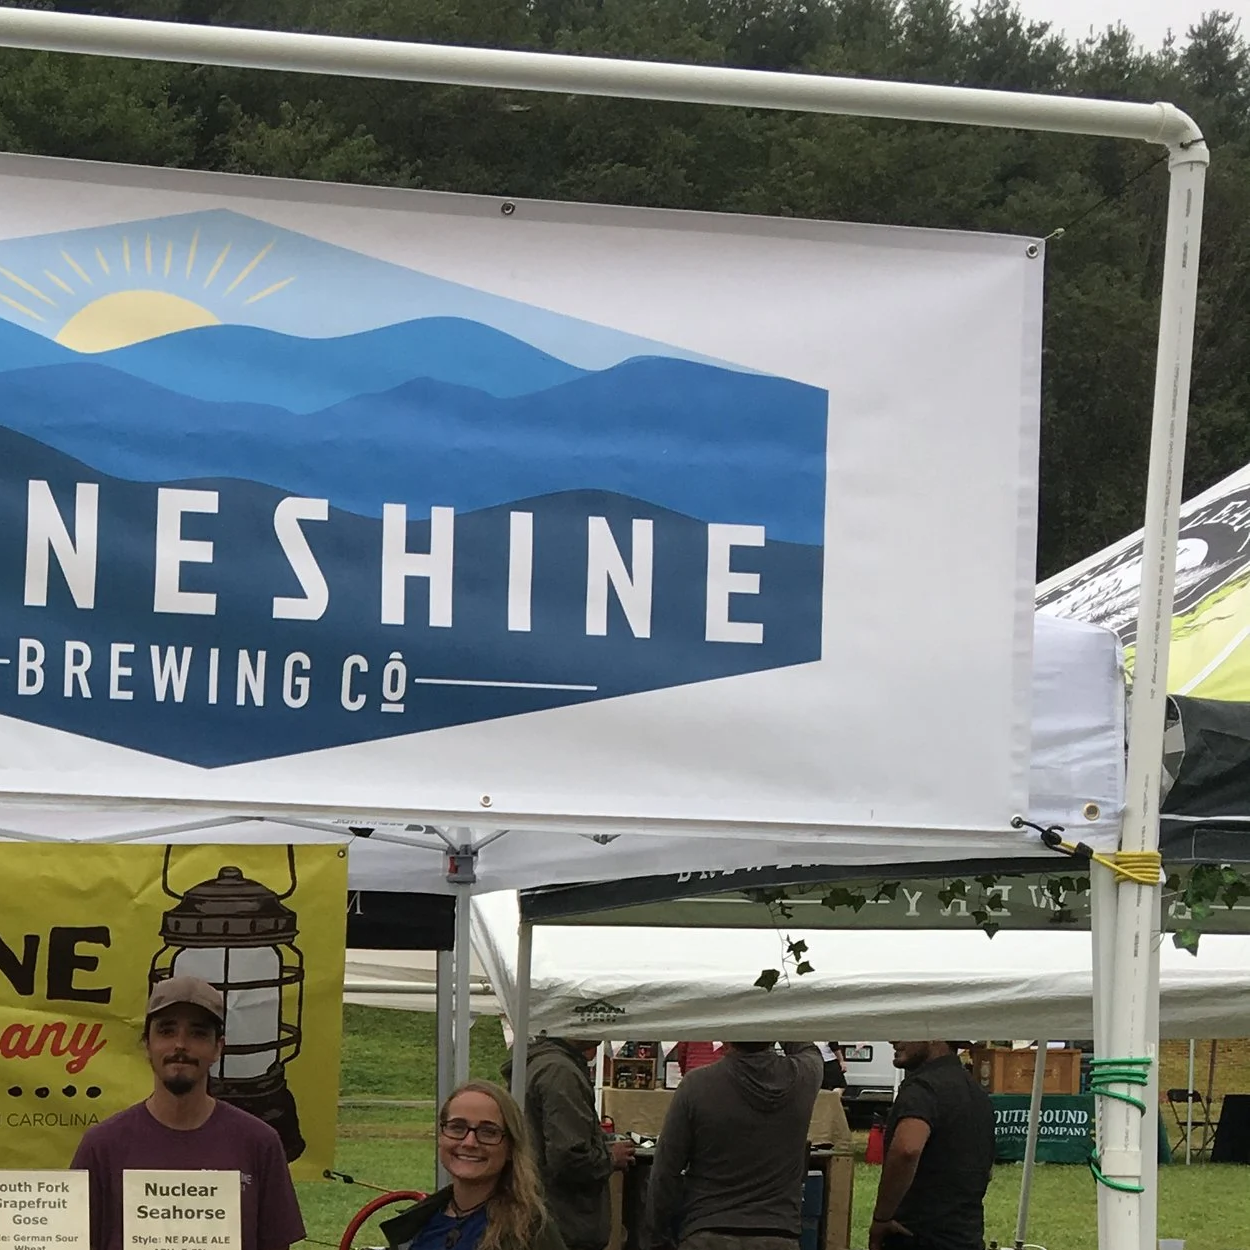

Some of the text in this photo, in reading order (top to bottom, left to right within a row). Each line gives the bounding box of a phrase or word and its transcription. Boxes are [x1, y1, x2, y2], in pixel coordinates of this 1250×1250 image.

[17, 639, 312, 711] BREWING
[7, 1112, 99, 1127] CAROLINA
[994, 1125, 1088, 1136] EWING OMPANY
[37, 1181, 70, 1193] Fork
[144, 1182, 218, 1197] Nuclear
[136, 1205, 226, 1220] Seahorse
[12, 1214, 48, 1226] Gose
[13, 1233, 52, 1242] German
[55, 1234, 79, 1242] Sour
[132, 1235, 230, 1245] Style: NE PALE ALE
